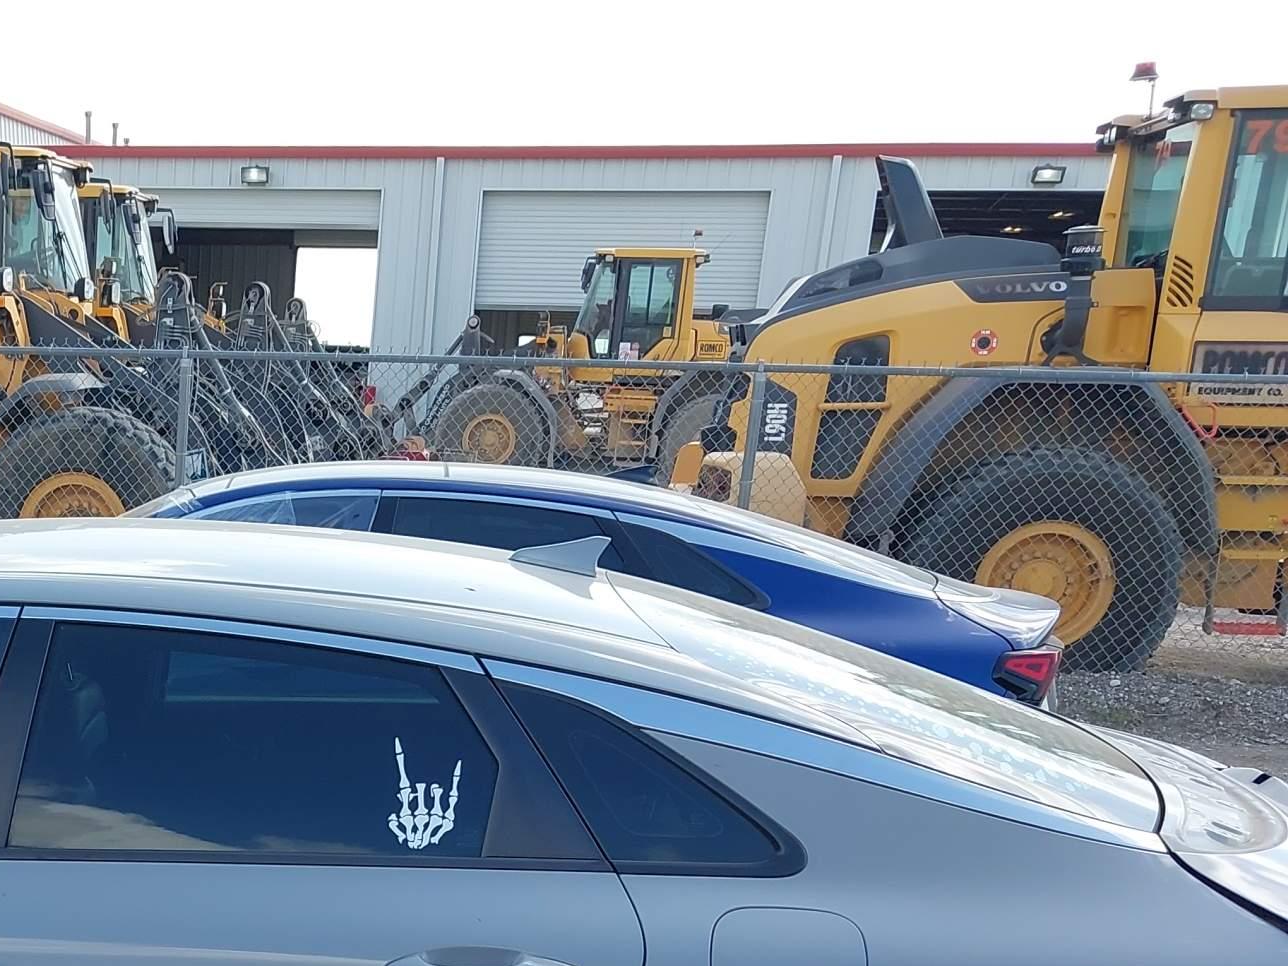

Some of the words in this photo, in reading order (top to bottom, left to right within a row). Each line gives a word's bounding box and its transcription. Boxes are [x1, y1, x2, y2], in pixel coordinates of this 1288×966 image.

[1246, 119, 1288, 154] 79
[976, 280, 1068, 295] VOLVO
[699, 342, 724, 353] ROMCO
[1197, 386, 1263, 396] EQUIPMENT
[764, 403, 788, 442] L90H
